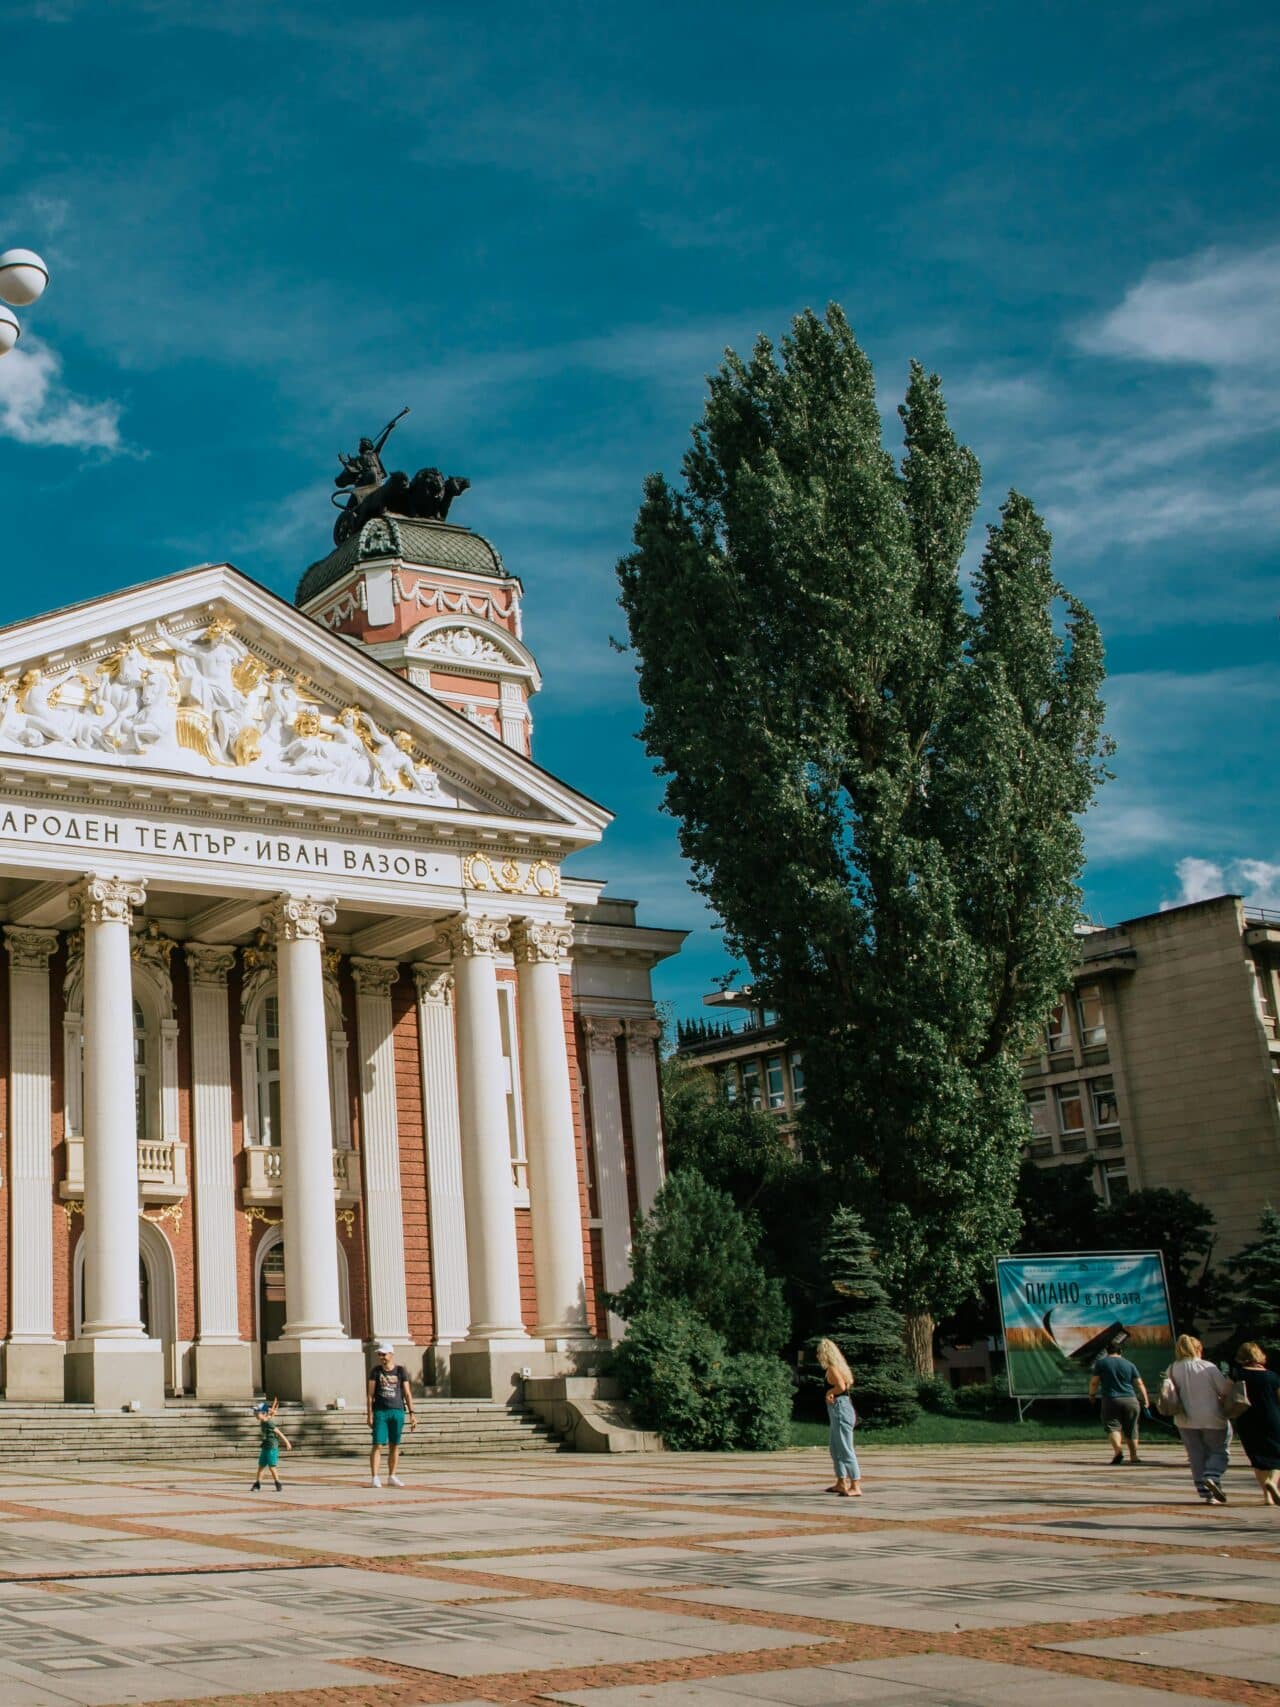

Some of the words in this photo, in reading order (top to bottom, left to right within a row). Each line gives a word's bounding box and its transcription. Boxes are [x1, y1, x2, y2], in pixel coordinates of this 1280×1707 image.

[135, 826, 236, 855] ТЕАТЪР
[256, 840, 328, 866] ИВАН
[344, 850, 428, 877] ВАЗОВ
[1025, 1281, 1080, 1304] ПИАНО
[1096, 1292, 1141, 1308] тревата
